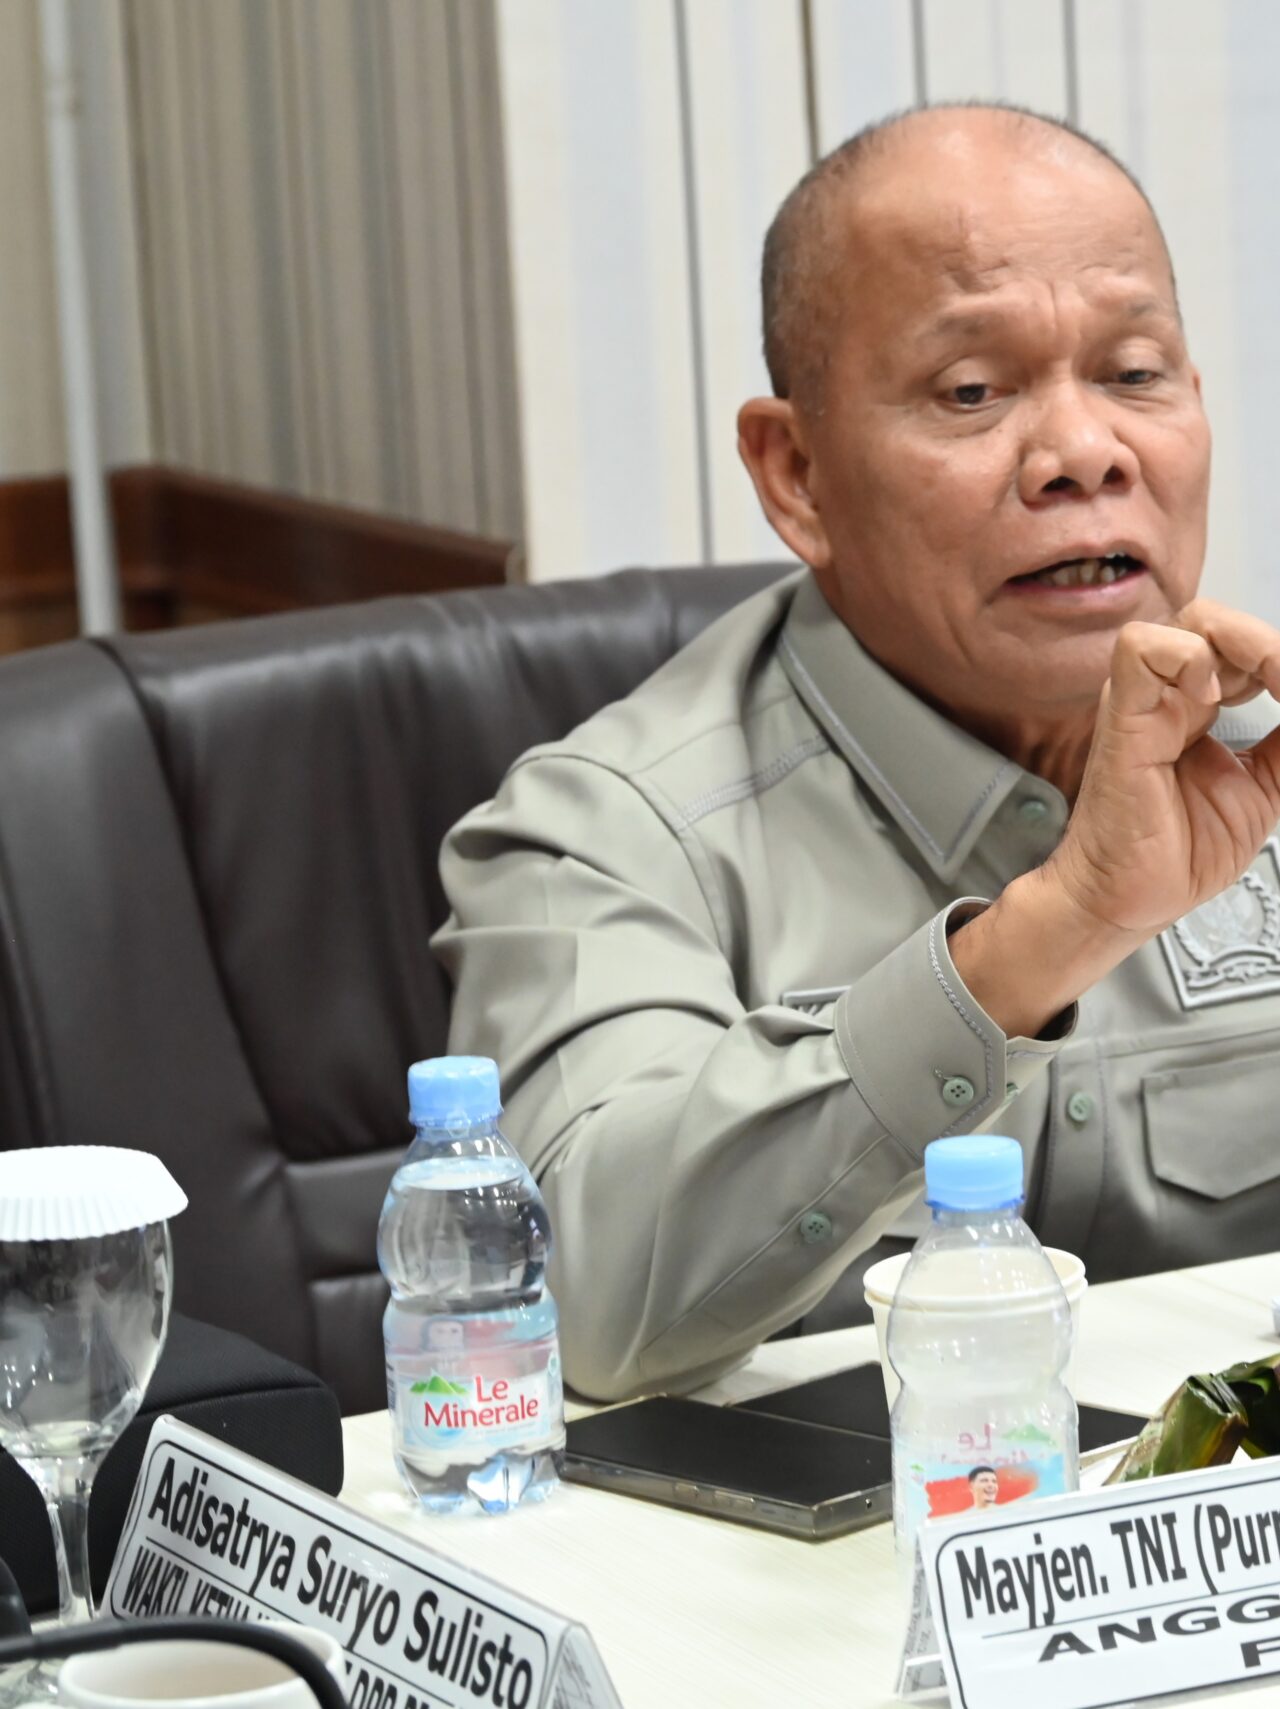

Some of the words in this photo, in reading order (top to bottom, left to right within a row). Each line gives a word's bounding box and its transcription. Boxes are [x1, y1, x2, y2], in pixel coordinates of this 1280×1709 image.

[424, 1395, 539, 1428] Minerale
[475, 1375, 508, 1402] Le
[148, 1457, 296, 1598] Adisatrya
[297, 1534, 401, 1651] Suryo
[402, 1590, 533, 1709] Sulisto
[955, 1532, 1110, 1629] Mayjen.
[1110, 1511, 1188, 1589] TNI
